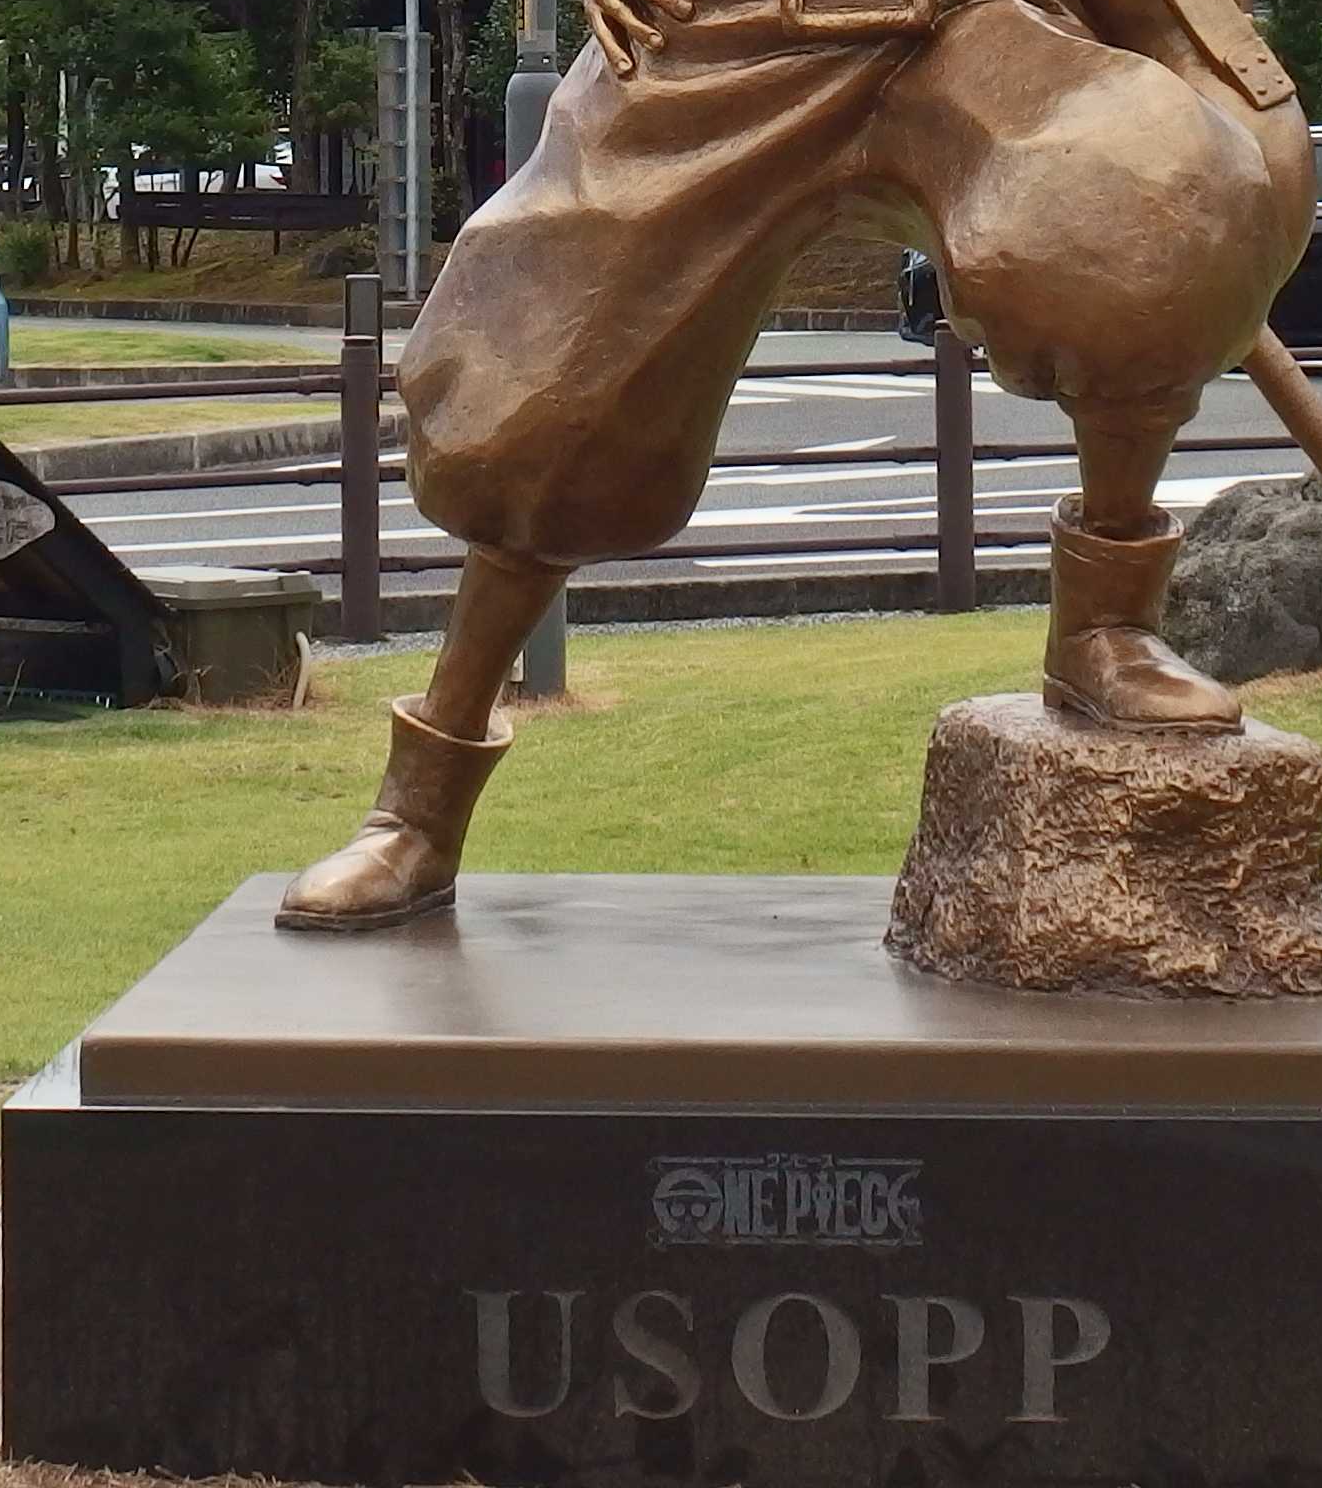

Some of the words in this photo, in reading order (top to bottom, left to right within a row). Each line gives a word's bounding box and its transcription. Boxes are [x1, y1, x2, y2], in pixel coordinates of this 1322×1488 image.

[652, 1167, 779, 1242] ONE
[785, 1167, 922, 1243] PIECE
[463, 1289, 1111, 1422] USOPP
